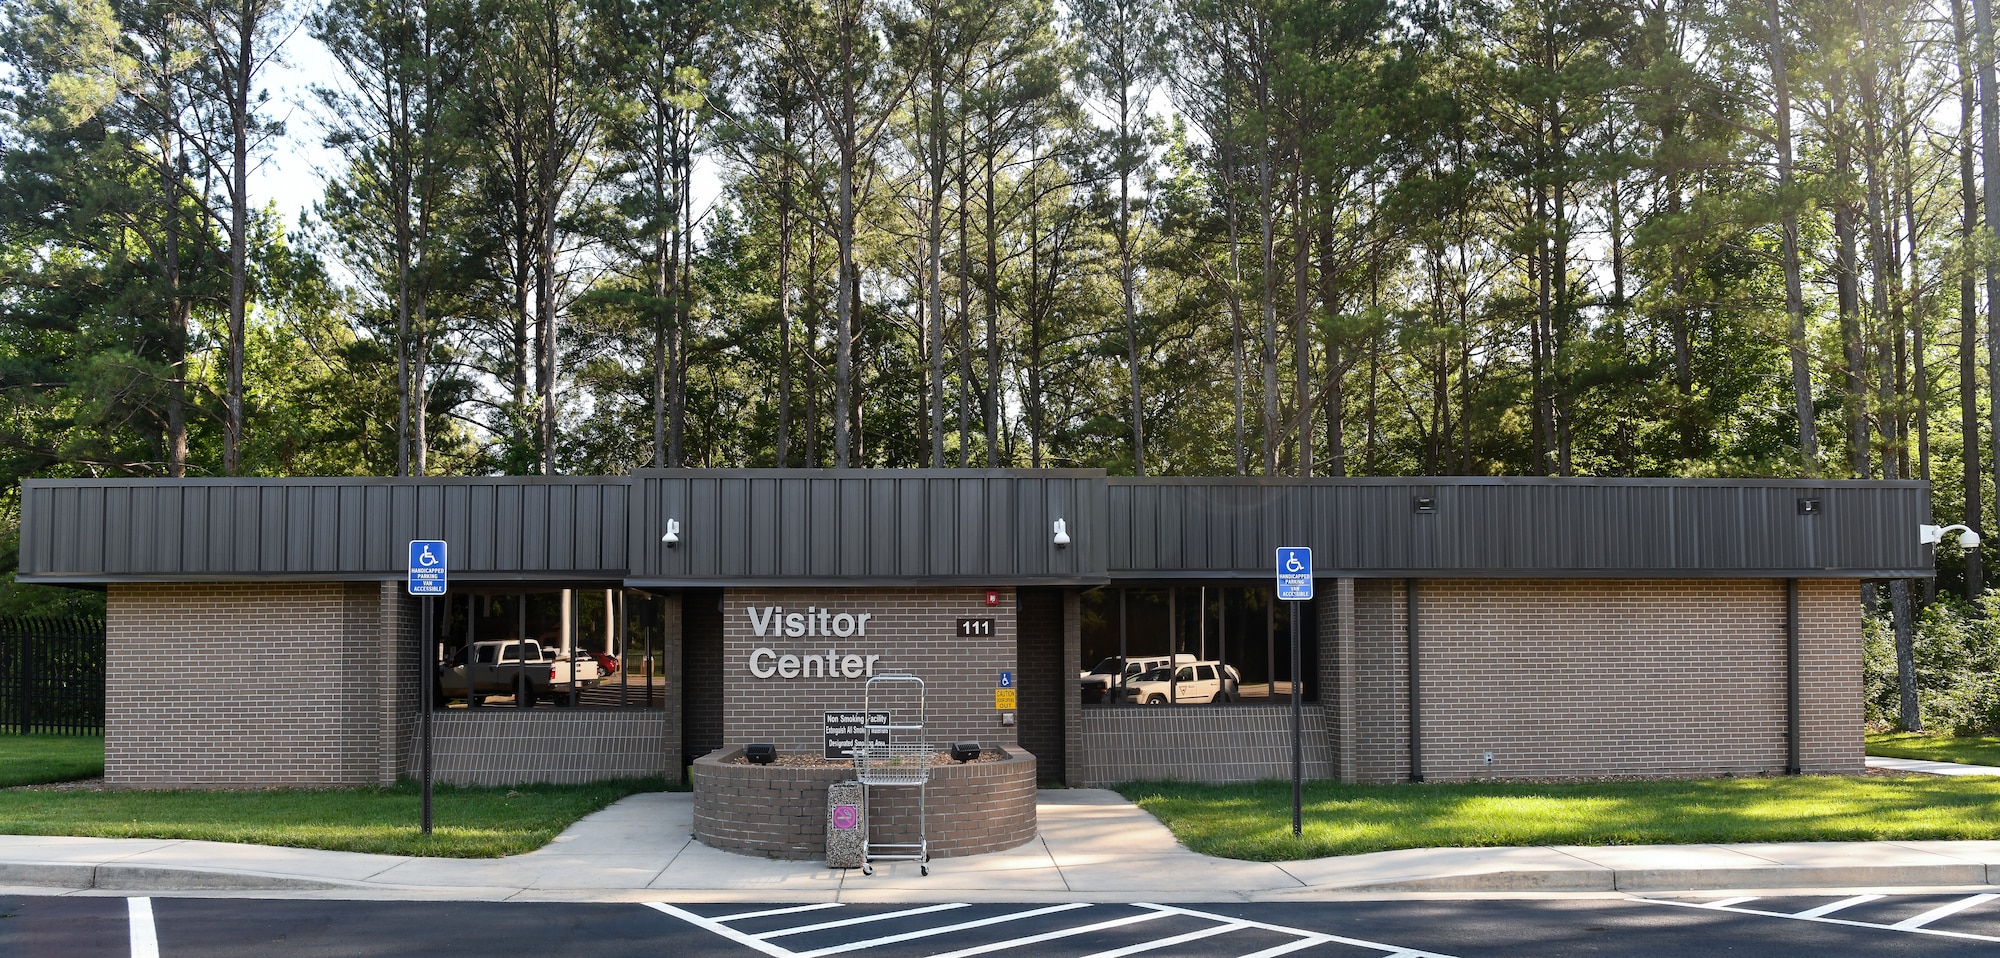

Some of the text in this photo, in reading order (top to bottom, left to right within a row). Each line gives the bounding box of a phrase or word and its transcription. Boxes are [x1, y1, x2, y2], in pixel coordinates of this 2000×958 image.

[747, 606, 872, 638] Visitor
[962, 620, 990, 635] 111
[748, 648, 880, 678] Center
[840, 714, 864, 724] Smoking
[829, 739, 853, 748] Designated
